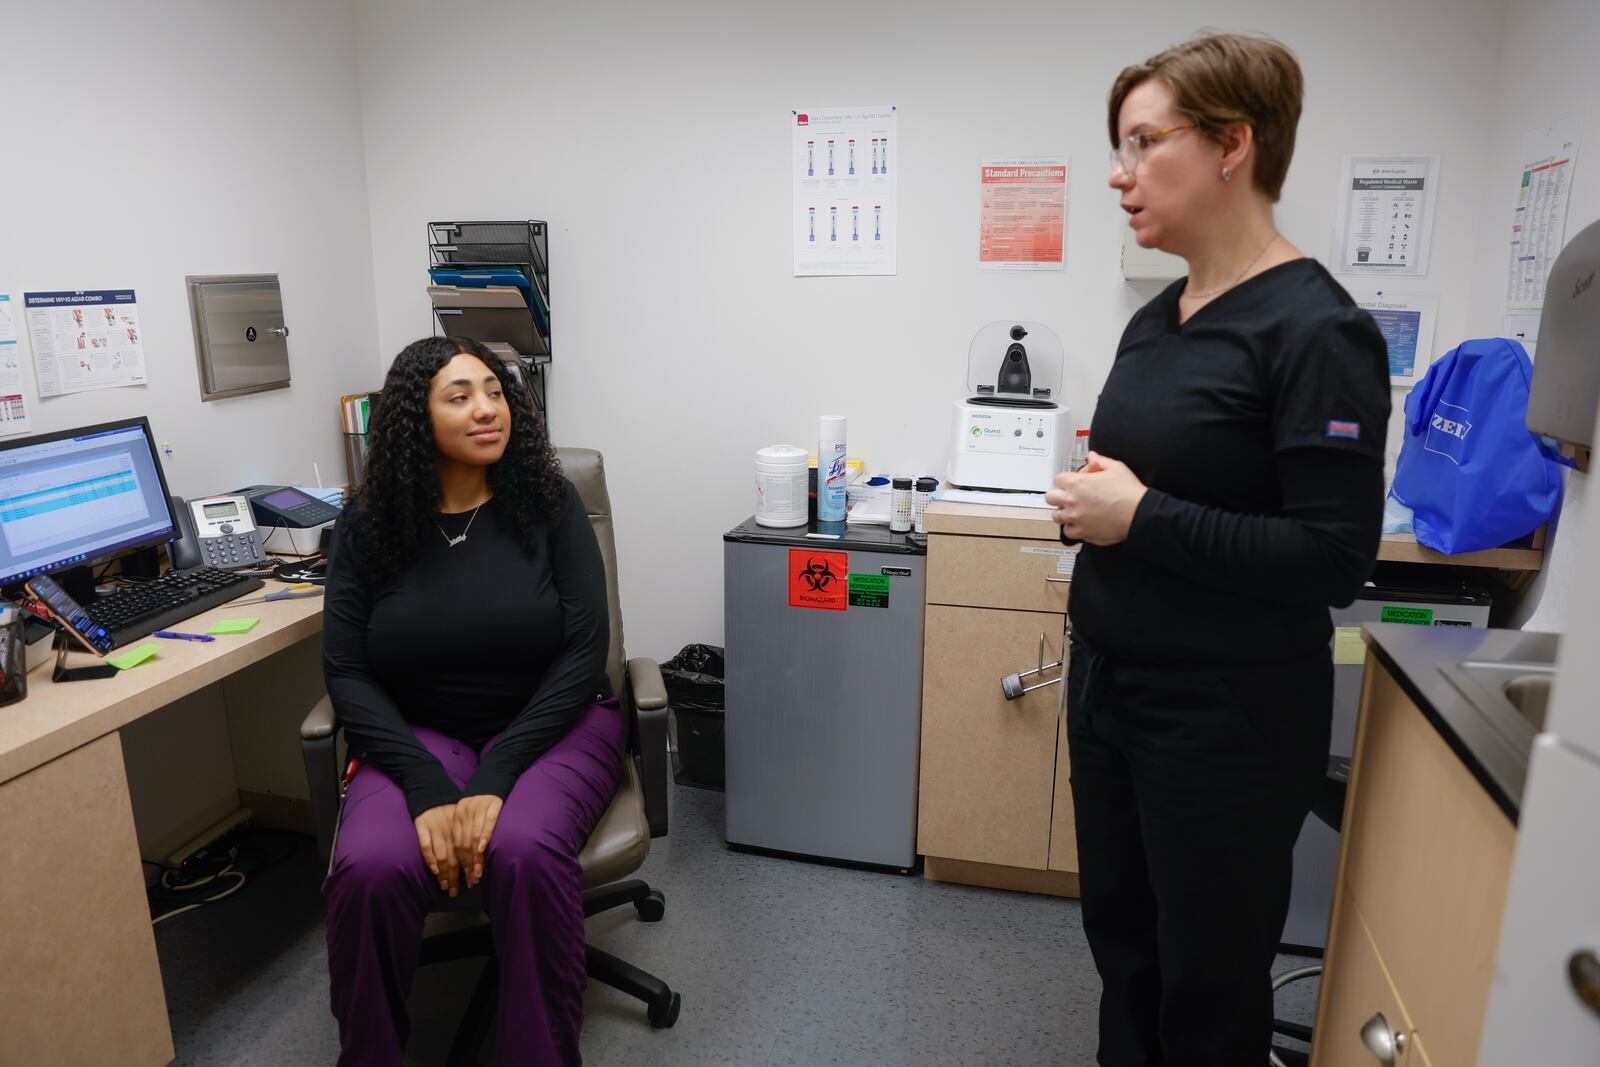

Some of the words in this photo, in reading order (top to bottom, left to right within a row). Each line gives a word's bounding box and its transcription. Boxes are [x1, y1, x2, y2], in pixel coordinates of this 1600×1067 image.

[985, 168, 1019, 178] Standard
[1020, 168, 1065, 177] Precautions
[28, 296, 55, 304] DETERMINE
[853, 576, 885, 585] MEDICATION
[849, 583, 889, 592] REFRIGERATOR
[800, 595, 836, 604] BIOHAZARD
[1387, 610, 1427, 619] MEDICATION
